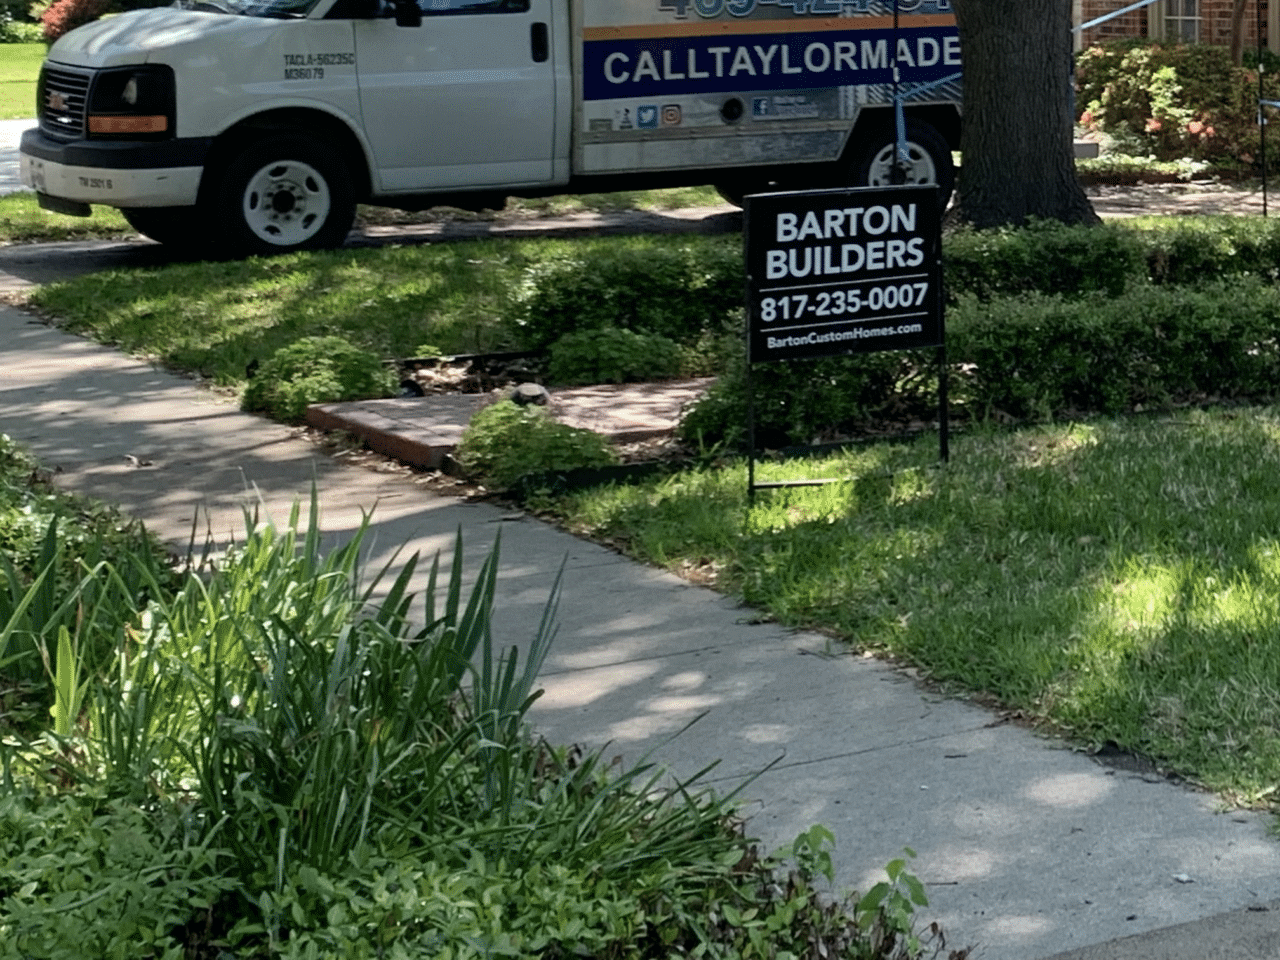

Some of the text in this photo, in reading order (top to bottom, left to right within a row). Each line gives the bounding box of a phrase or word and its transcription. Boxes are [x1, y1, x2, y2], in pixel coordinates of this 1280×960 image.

[776, 203, 917, 243] BARTON
[765, 237, 925, 280] BUILDERS
[760, 282, 929, 322] 817-235-0007
[766, 323, 923, 349] BartonCustomHomes.com
